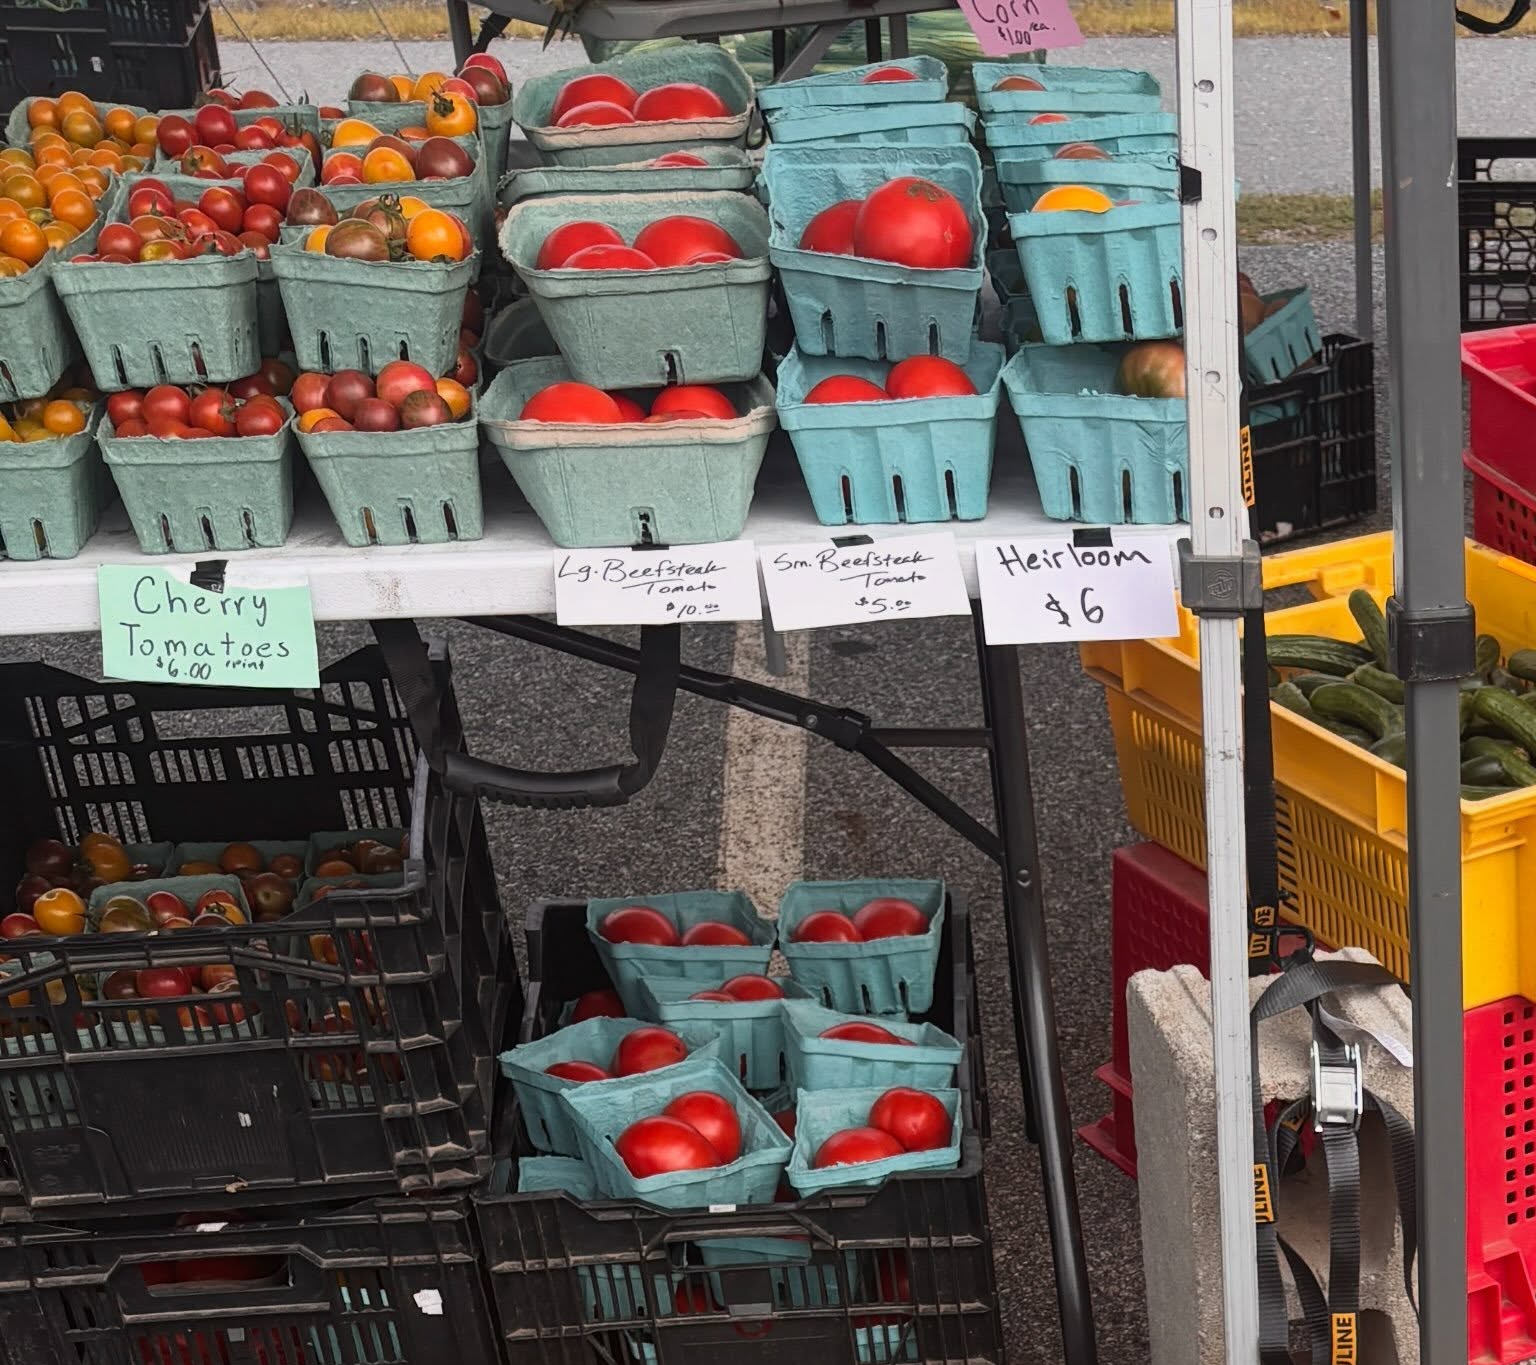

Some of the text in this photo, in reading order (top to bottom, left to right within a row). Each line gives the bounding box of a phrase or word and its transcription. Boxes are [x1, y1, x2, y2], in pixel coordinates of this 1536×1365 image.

[971, 0, 1040, 24] Corn
[774, 548, 934, 572] Sm. Beefsteak
[997, 543, 1152, 577] Heirloom
[134, 576, 268, 628] Cherry
[120, 622, 290, 658] Tomatoes
[156, 656, 212, 680] $6.00
[1251, 908, 1271, 954] ULNE
